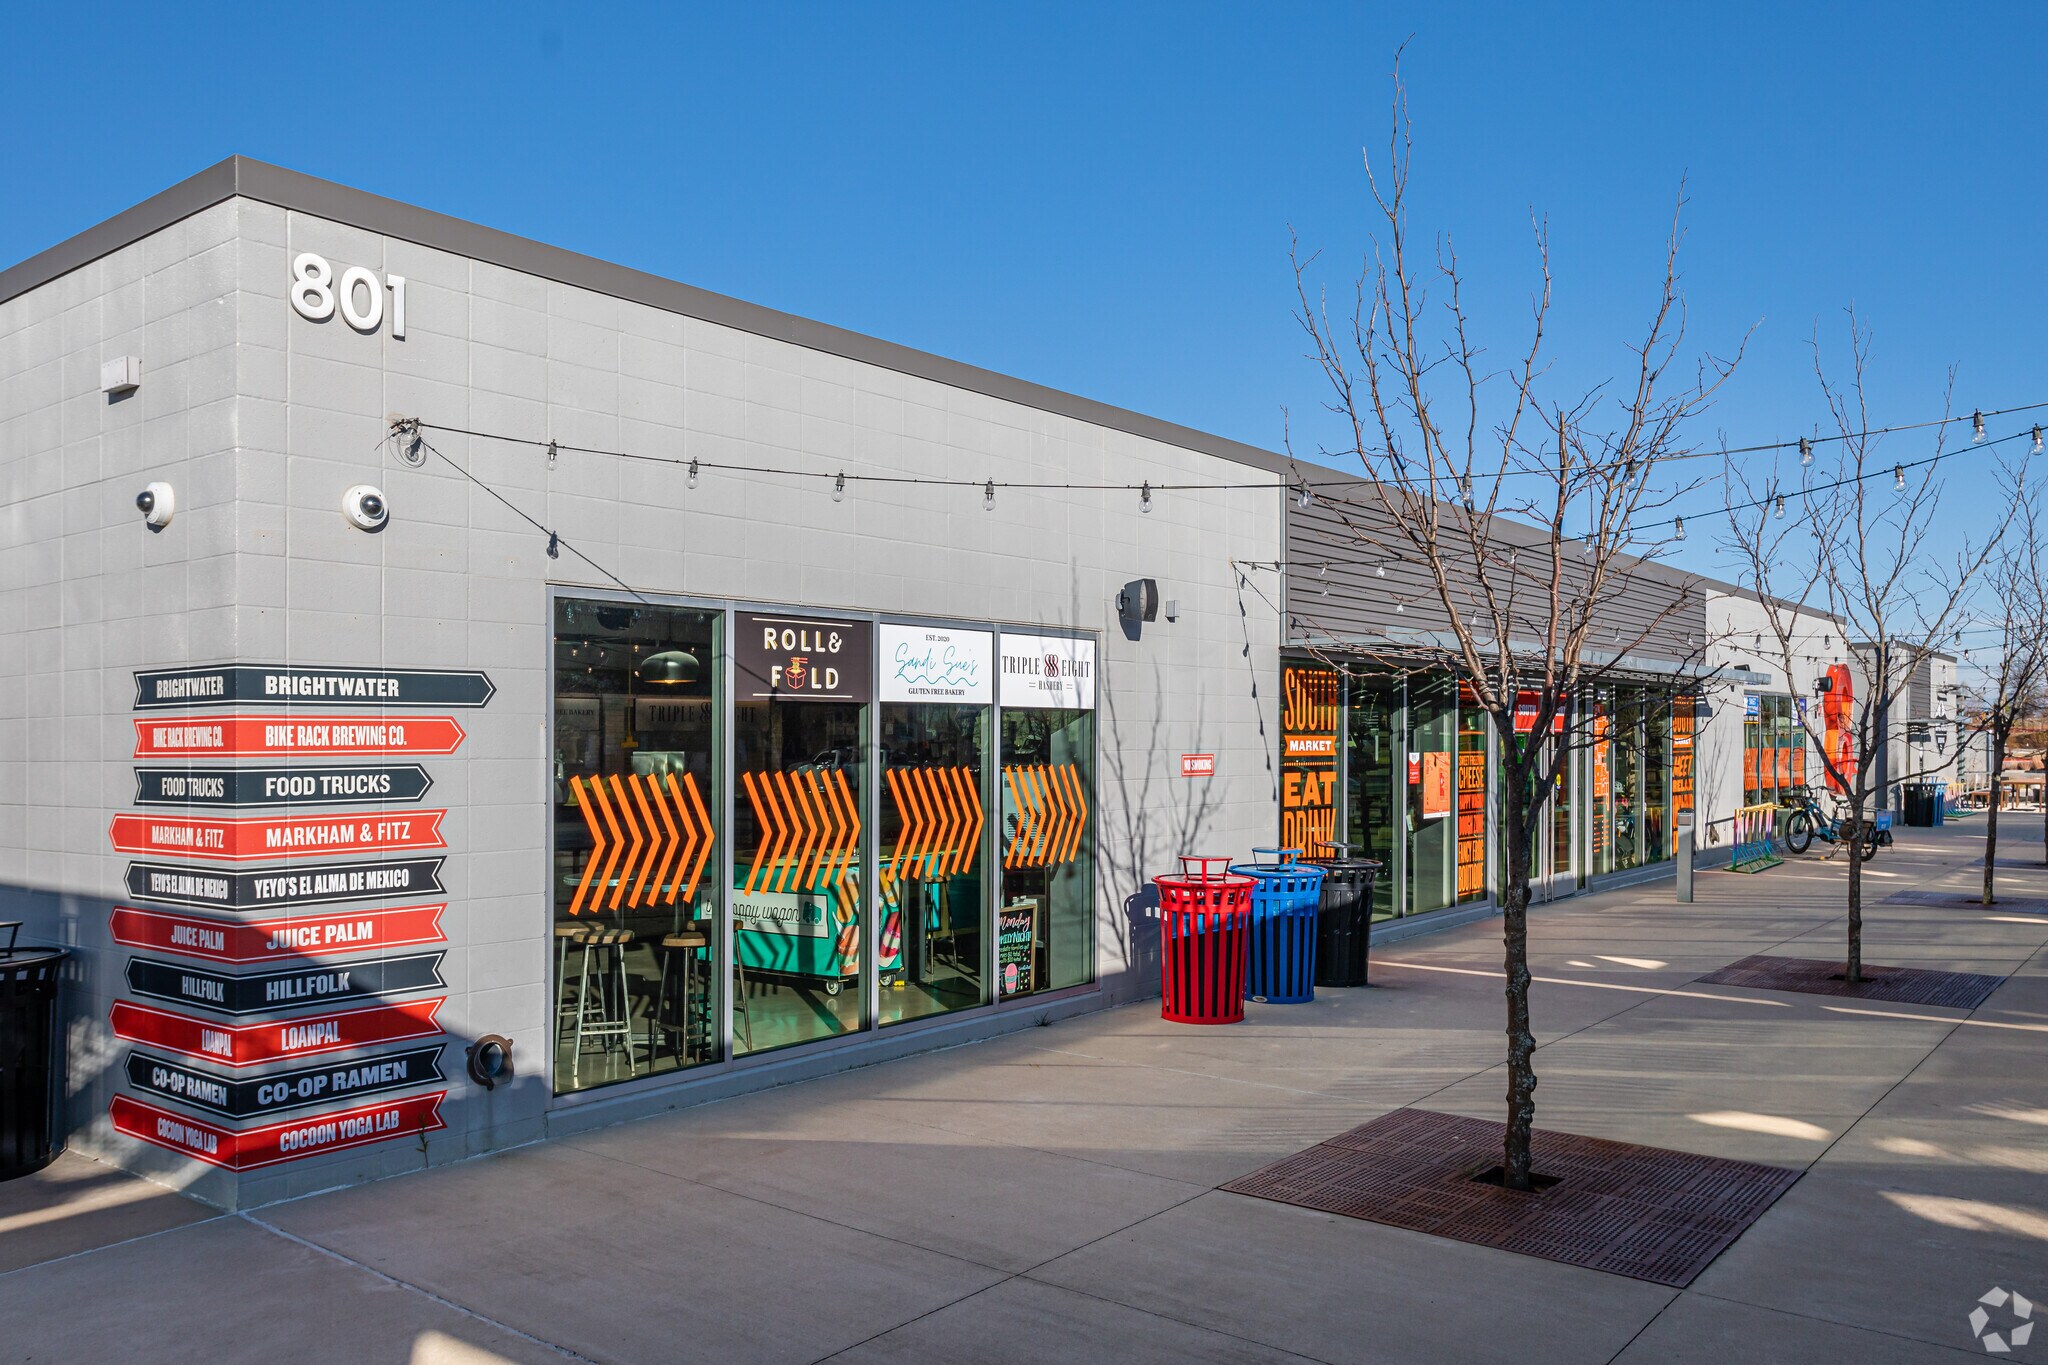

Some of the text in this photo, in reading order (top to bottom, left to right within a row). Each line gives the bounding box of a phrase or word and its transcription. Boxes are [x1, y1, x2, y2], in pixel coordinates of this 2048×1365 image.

[291, 252, 406, 341] 801
[1002, 656, 1040, 675] TRIPLE
[1062, 660, 1091, 677] EIGHT
[156, 676, 224, 698] BRIGHTWATER
[265, 676, 399, 697] BRIGHTWATER
[1284, 667, 1337, 731] SOUTH
[649, 705, 695, 723] TRIPLE
[1518, 704, 1536, 716] SOUTH
[153, 726, 224, 748] BIKE RACK BREWING CO.
[265, 725, 407, 747] BIKE RACK BREWING CO.
[1290, 740, 1331, 751] MARKET
[162, 777, 224, 797] FOOD TRUCKS
[266, 774, 390, 797] FOOD TRUCKS
[1284, 771, 1336, 807] EAT
[1459, 766, 1484, 789] CHEESE
[152, 826, 224, 848] MARKHAM & FITZ
[266, 821, 411, 847] MARKHAM & FITZ
[1284, 808, 1337, 859] DRINK
[171, 874, 178, 894] EL
[178, 876, 195, 895] ALMA
[195, 877, 204, 896] DE
[204, 878, 228, 900] MEXICO
[254, 868, 410, 899] YEYO'S EL ALMA DE MEXICO
[762, 906, 800, 927] wagon
[171, 925, 224, 951] JUICE PALM
[266, 921, 373, 950] JUICE PALM
[182, 975, 224, 1002] HILLFOLK
[266, 972, 350, 1001] HILLFOLK
[202, 1028, 232, 1057] LOANPAL
[281, 1021, 341, 1050] LOANPAL
[152, 1066, 227, 1106] CO-OP RAMEN
[257, 1060, 407, 1105] CO-OP RAMEN
[157, 1117, 217, 1154] COCOON YOGA LAB
[280, 1110, 399, 1151] COCOON YOGA LAB
